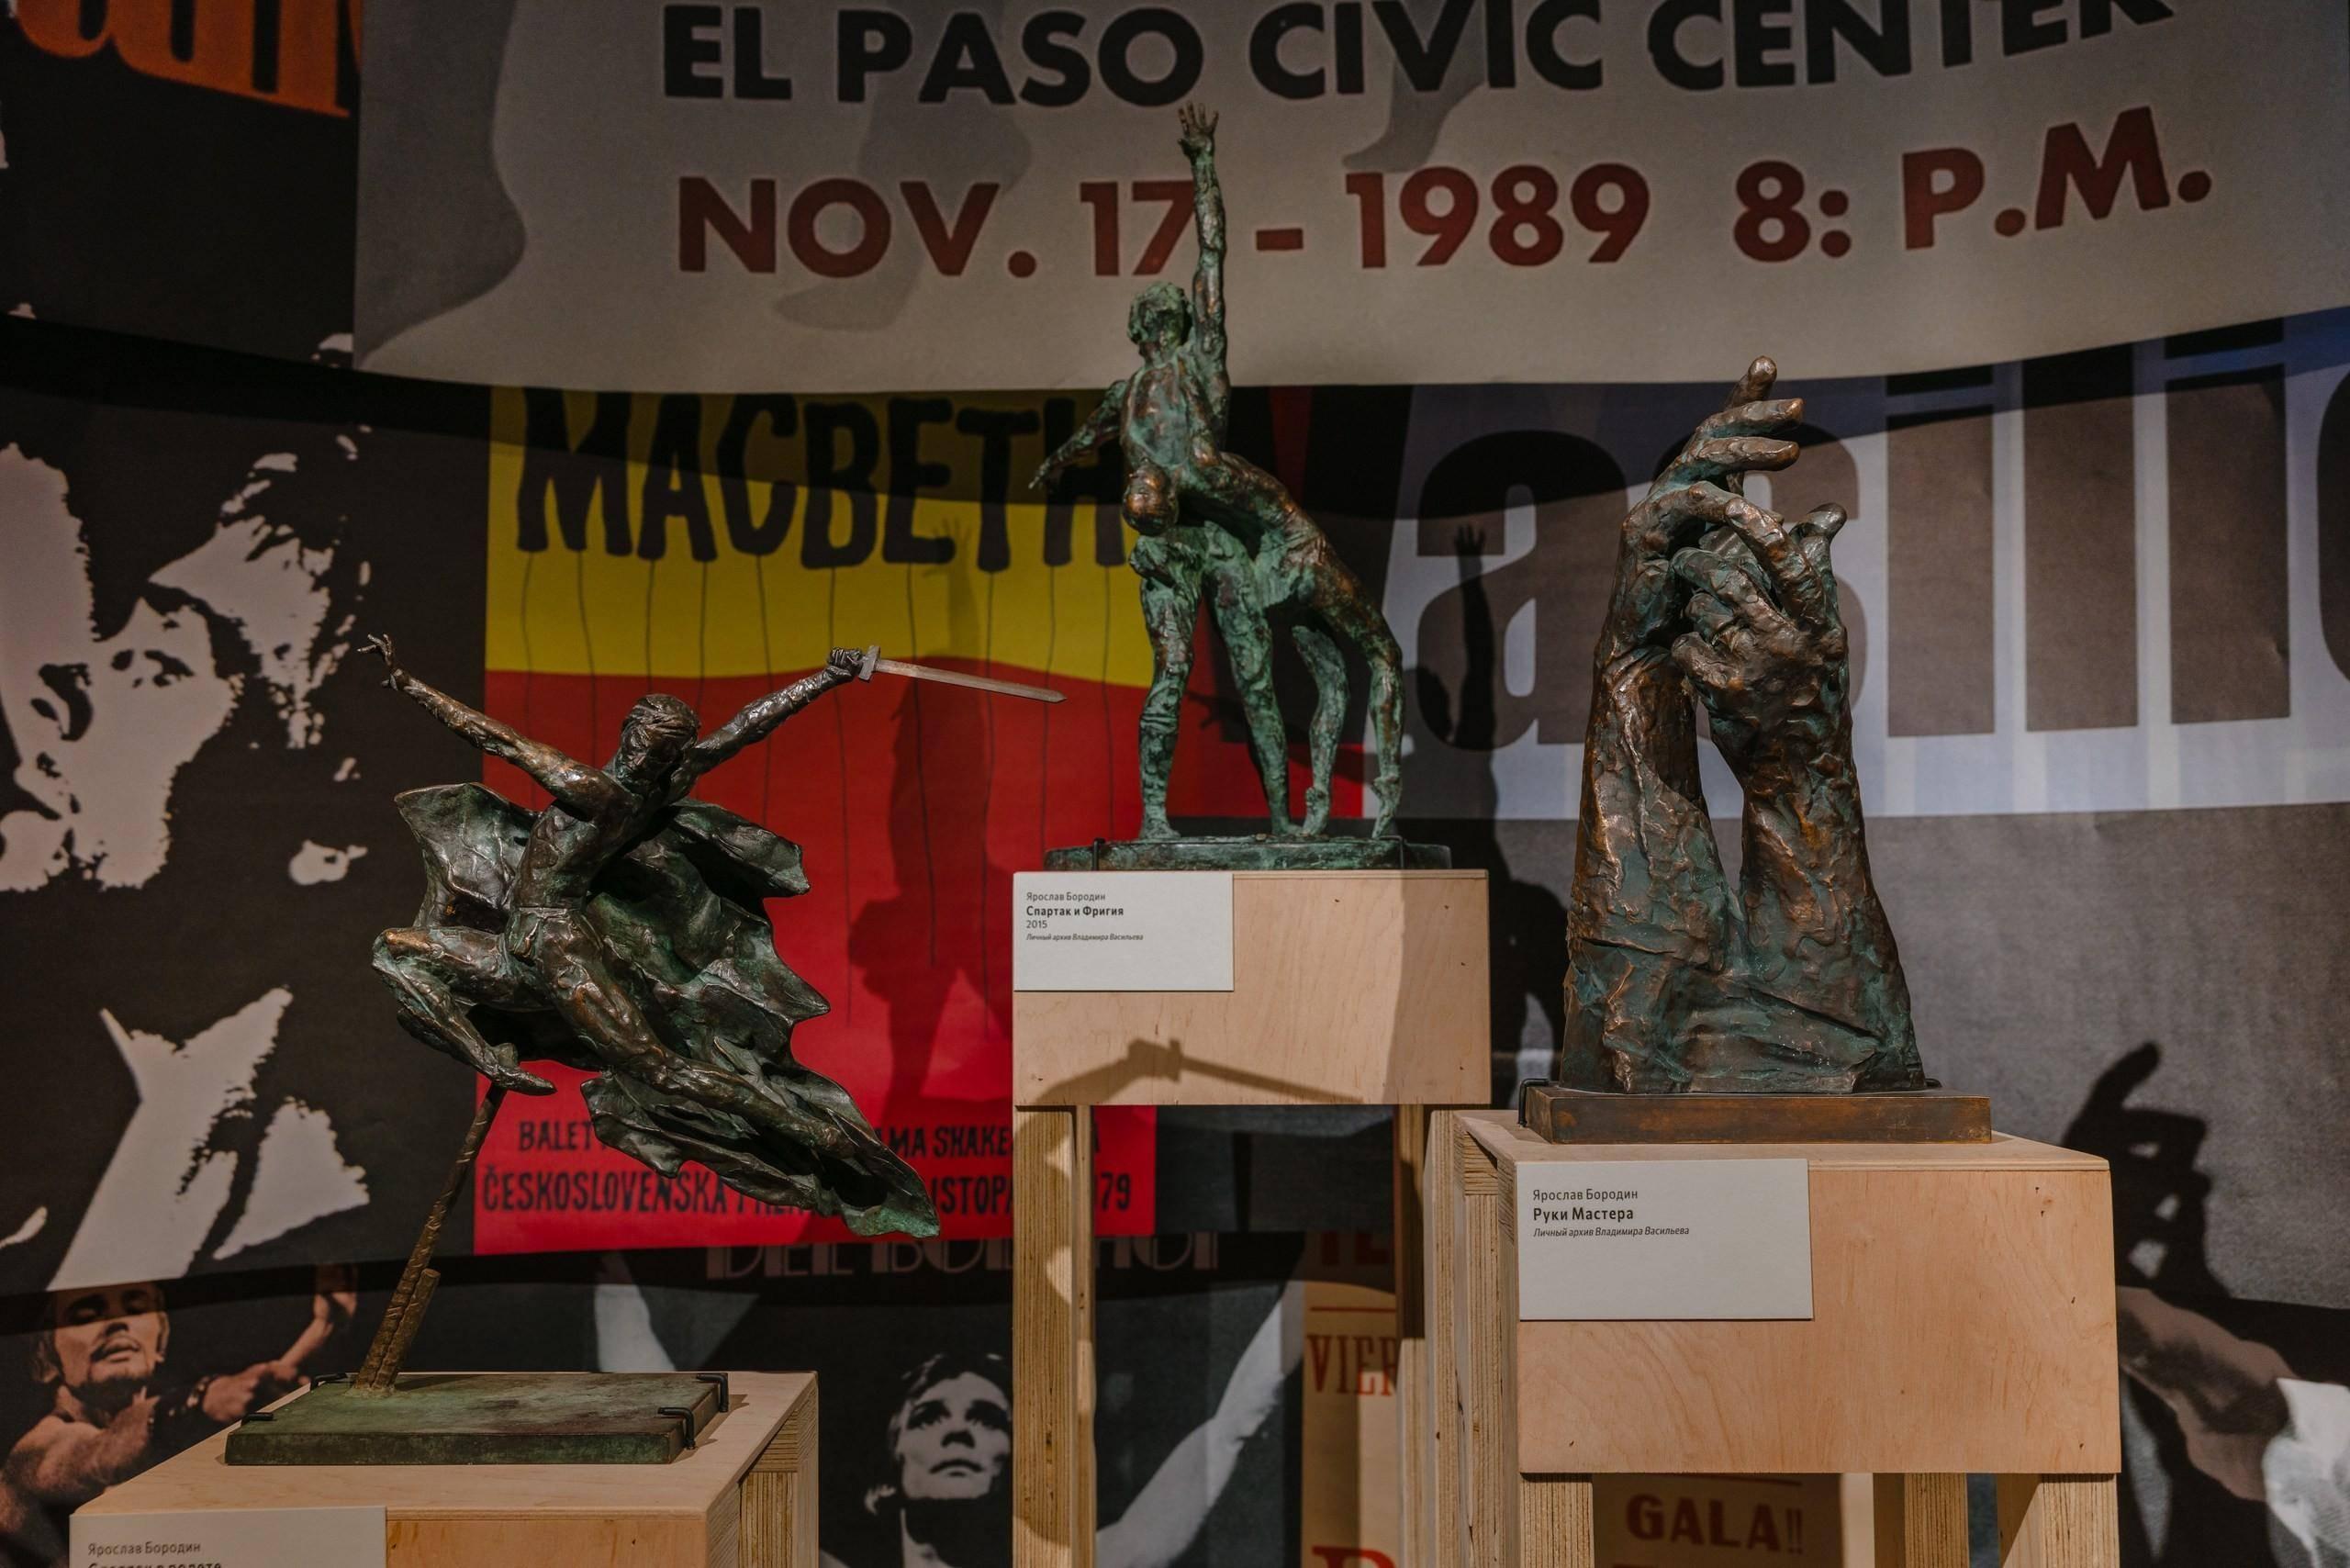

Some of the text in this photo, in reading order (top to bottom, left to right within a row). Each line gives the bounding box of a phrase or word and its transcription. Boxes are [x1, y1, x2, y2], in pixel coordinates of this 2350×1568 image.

[663, 5, 791, 100] EL
[837, 7, 1203, 106] PASO
[1249, 0, 1603, 100] CIVIC
[678, 176, 1036, 278] NOV.
[1080, 182, 1198, 277] 17
[1345, 162, 1651, 268] 1989
[1733, 160, 1850, 263] 8:
[1901, 106, 2212, 252] P.M.
[518, 389, 1126, 572] MACBETH
[1026, 890, 1106, 902] Ярослав Бородин
[1026, 905, 1125, 918] Спартак и Фригия
[1026, 919, 1048, 929] 2015
[1026, 933, 1052, 941] Личный
[1072, 933, 1109, 942] Владимира
[1109, 933, 1144, 941] Васильева
[519, 1121, 594, 1150] BALET
[934, 1125, 1013, 1158] SHAKE
[1533, 1188, 1639, 1203] Ярослав Бородин
[1533, 1207, 1634, 1223] Руки Мастера
[1533, 1226, 1690, 1238] Личный архив Владимира Васильева
[1626, 1493, 1803, 1554] GALA!!
[88, 1541, 201, 1557] Ярослав Бородин
